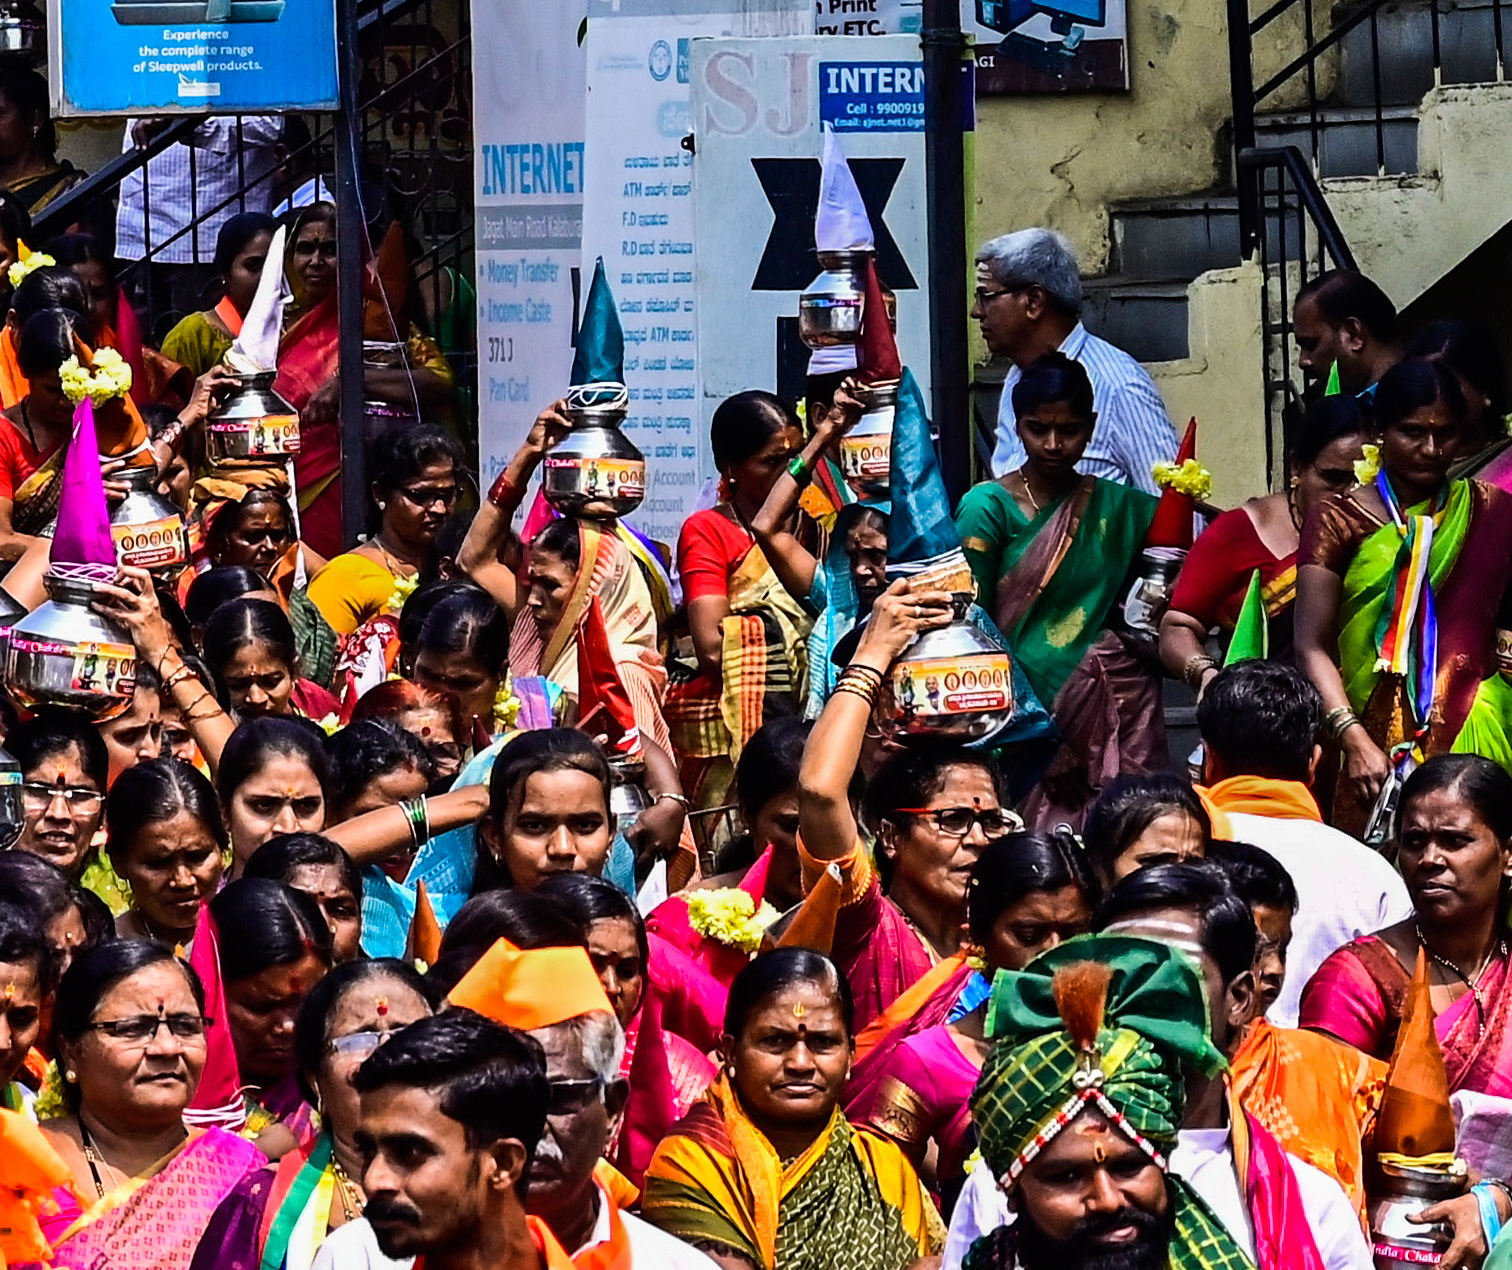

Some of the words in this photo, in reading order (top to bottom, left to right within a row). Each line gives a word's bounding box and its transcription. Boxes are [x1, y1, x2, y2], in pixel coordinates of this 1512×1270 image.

[163, 29, 229, 43] Experience
[139, 45, 158, 56] the
[161, 45, 218, 58] complete
[220, 45, 254, 58] range
[133, 61, 146, 72] of
[148, 59, 204, 74] Sleepwell
[206, 59, 263, 73] products.
[846, 103, 867, 115] Cell
[482, 142, 584, 196] INTERNET
[623, 183, 642, 198] ATM
[622, 241, 637, 256] R.D
[487, 260, 519, 287] Money
[520, 257, 560, 283] Transfer
[487, 298, 523, 323] Income
[650, 327, 670, 342] ATM
[488, 336, 506, 363] 371
[489, 377, 510, 402] Pan
[654, 468, 696, 486] Account
